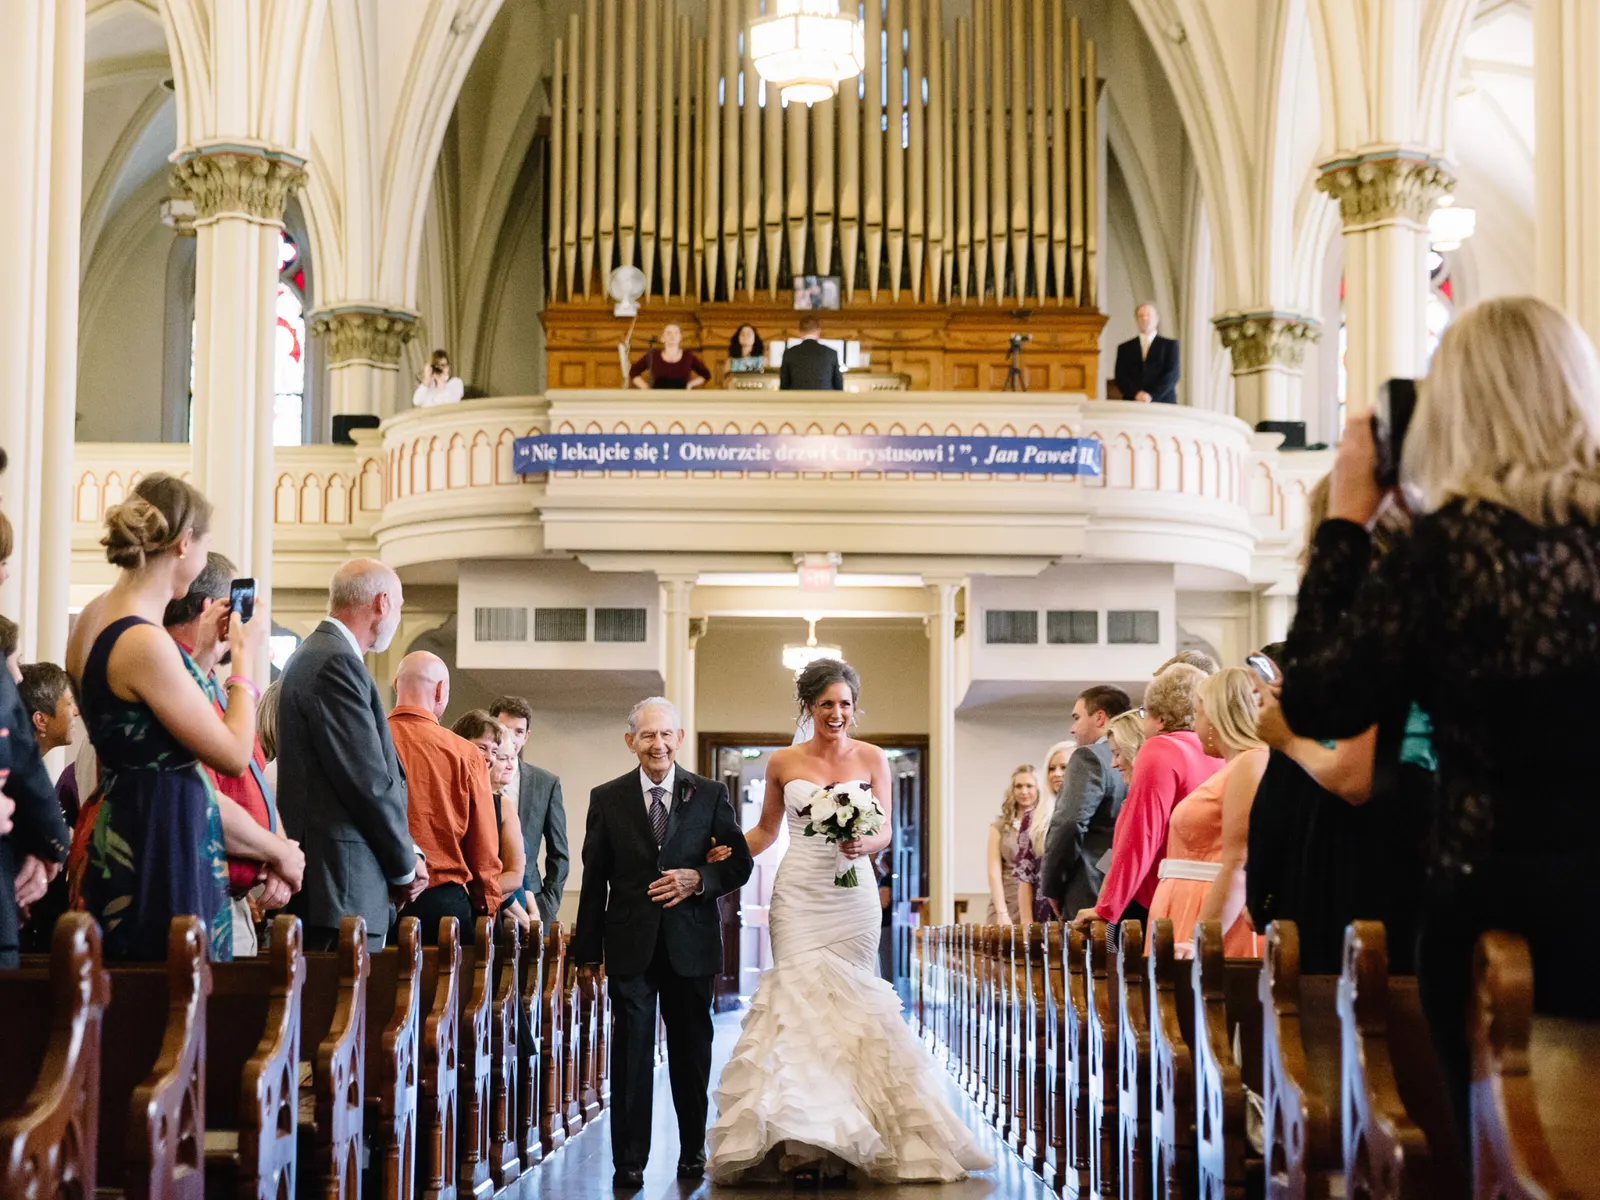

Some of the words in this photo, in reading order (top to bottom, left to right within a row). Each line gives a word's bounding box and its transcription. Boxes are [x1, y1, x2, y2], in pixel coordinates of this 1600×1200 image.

[562, 442, 630, 464] lekajcie
[680, 442, 771, 461] Otwórzcie
[983, 444, 1019, 465] Jan
